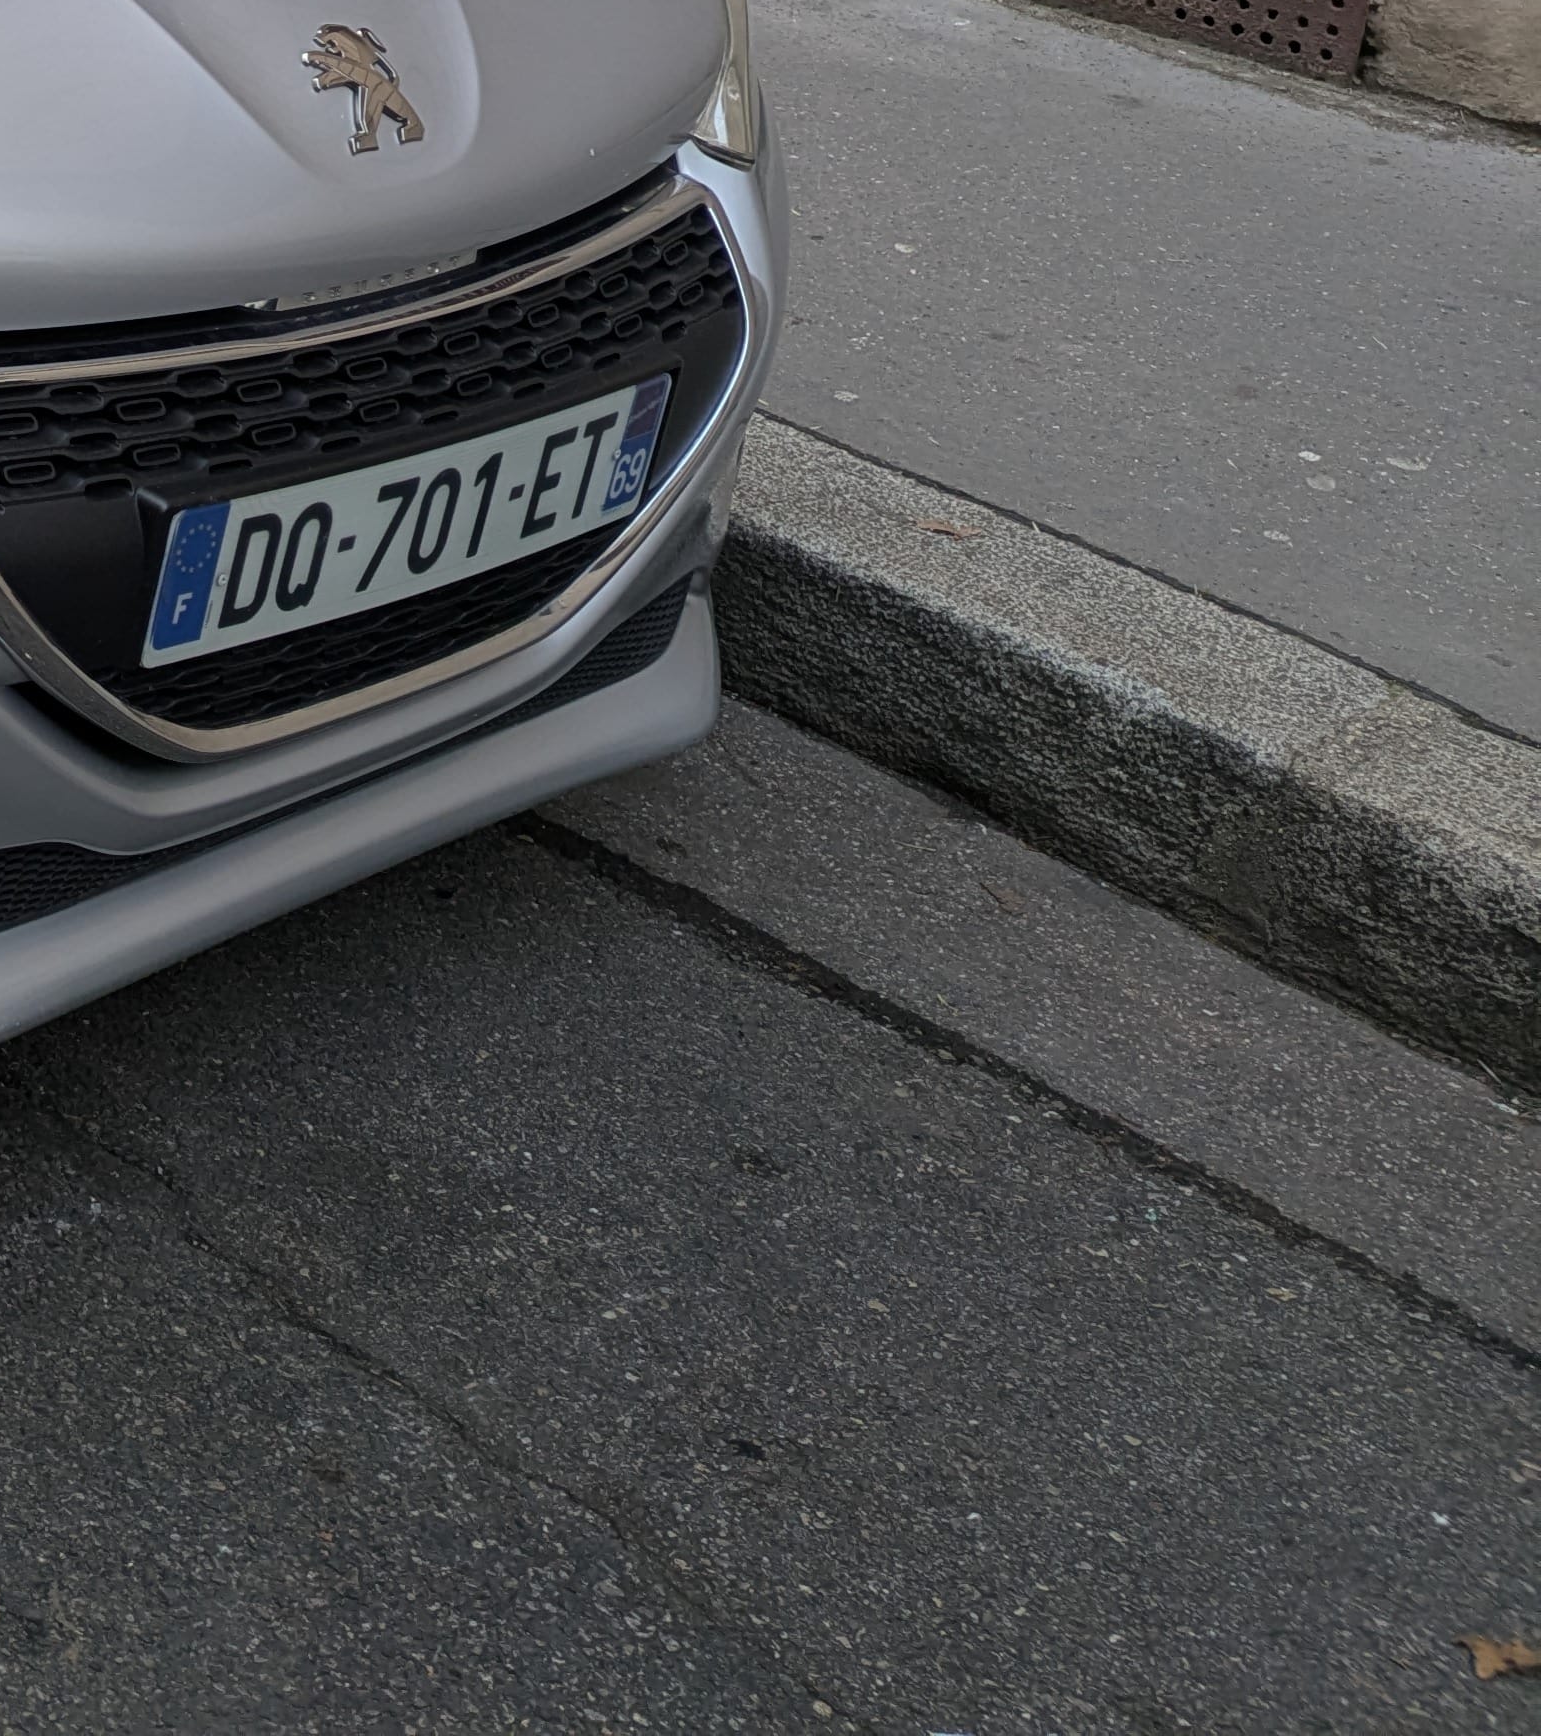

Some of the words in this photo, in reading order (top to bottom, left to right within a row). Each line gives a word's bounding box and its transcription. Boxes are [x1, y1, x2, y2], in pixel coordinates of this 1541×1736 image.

[171, 592, 194, 625] F
[217, 410, 620, 629] DQ-701-ET
[609, 447, 647, 500] 69
